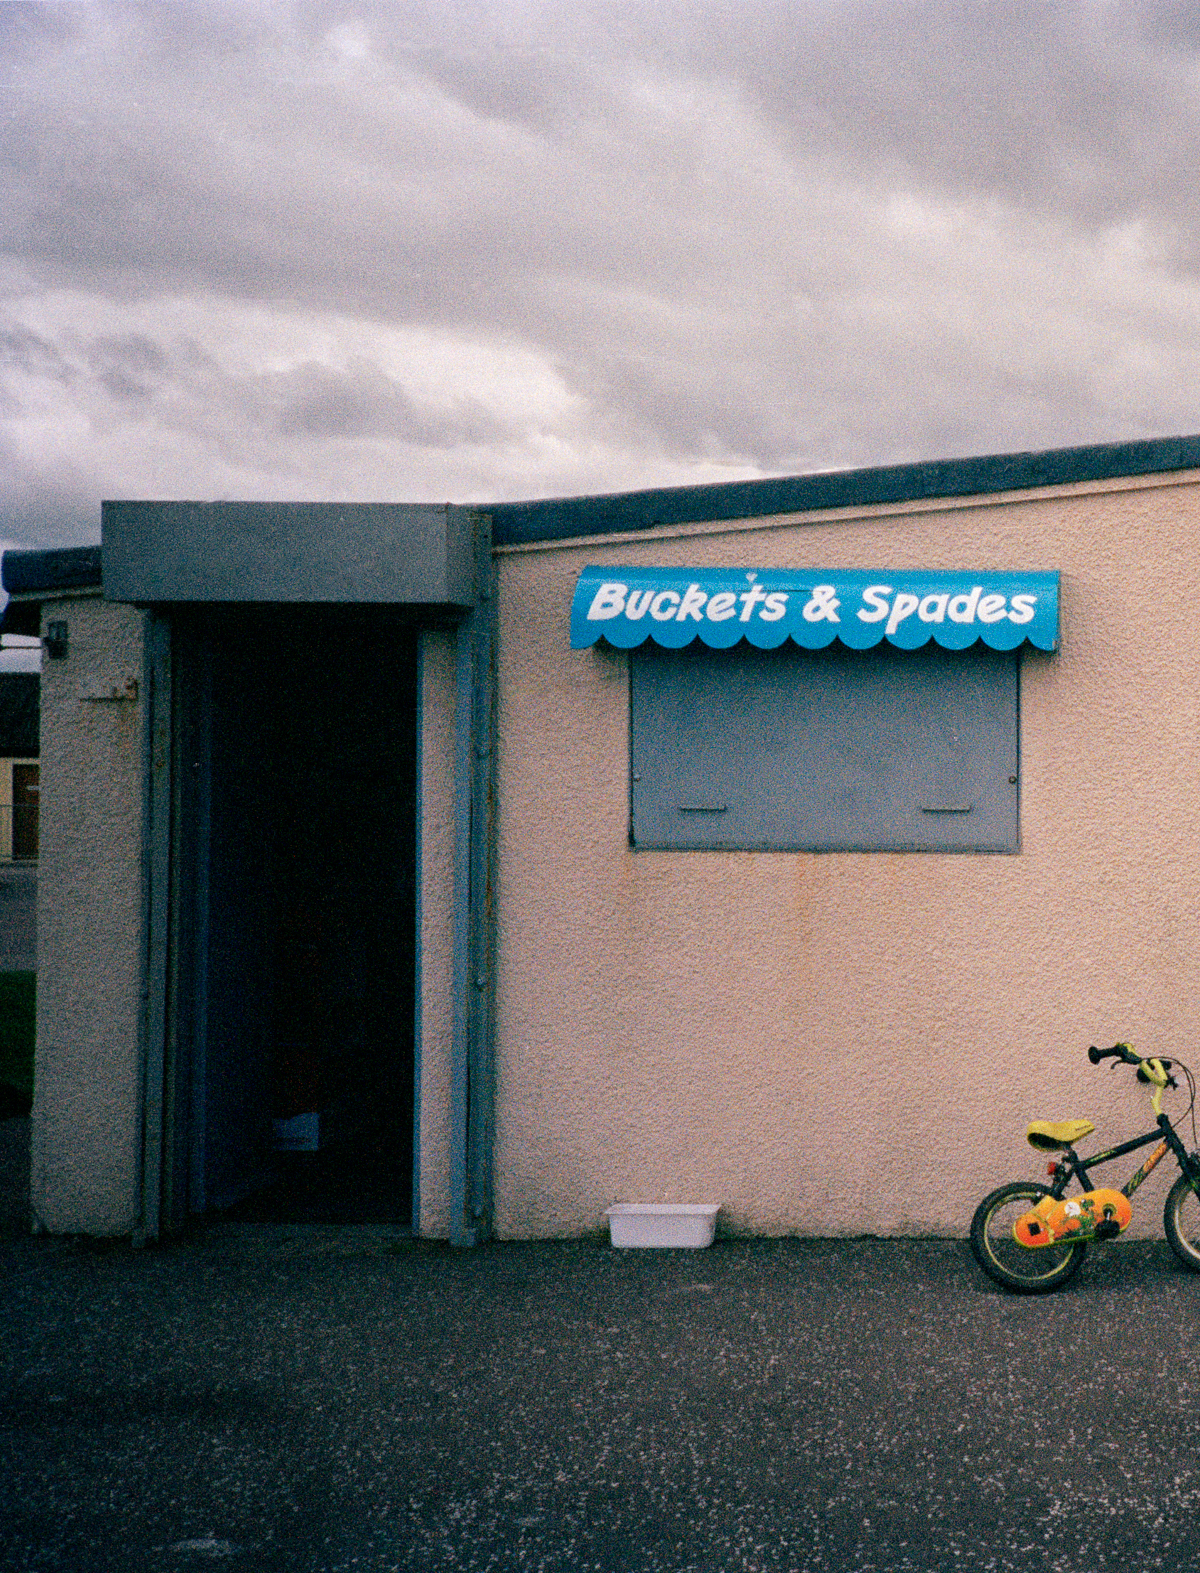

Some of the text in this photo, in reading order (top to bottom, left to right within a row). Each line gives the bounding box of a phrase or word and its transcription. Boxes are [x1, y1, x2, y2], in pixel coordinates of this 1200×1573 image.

[586, 583, 1038, 635] Buckets & Spades
